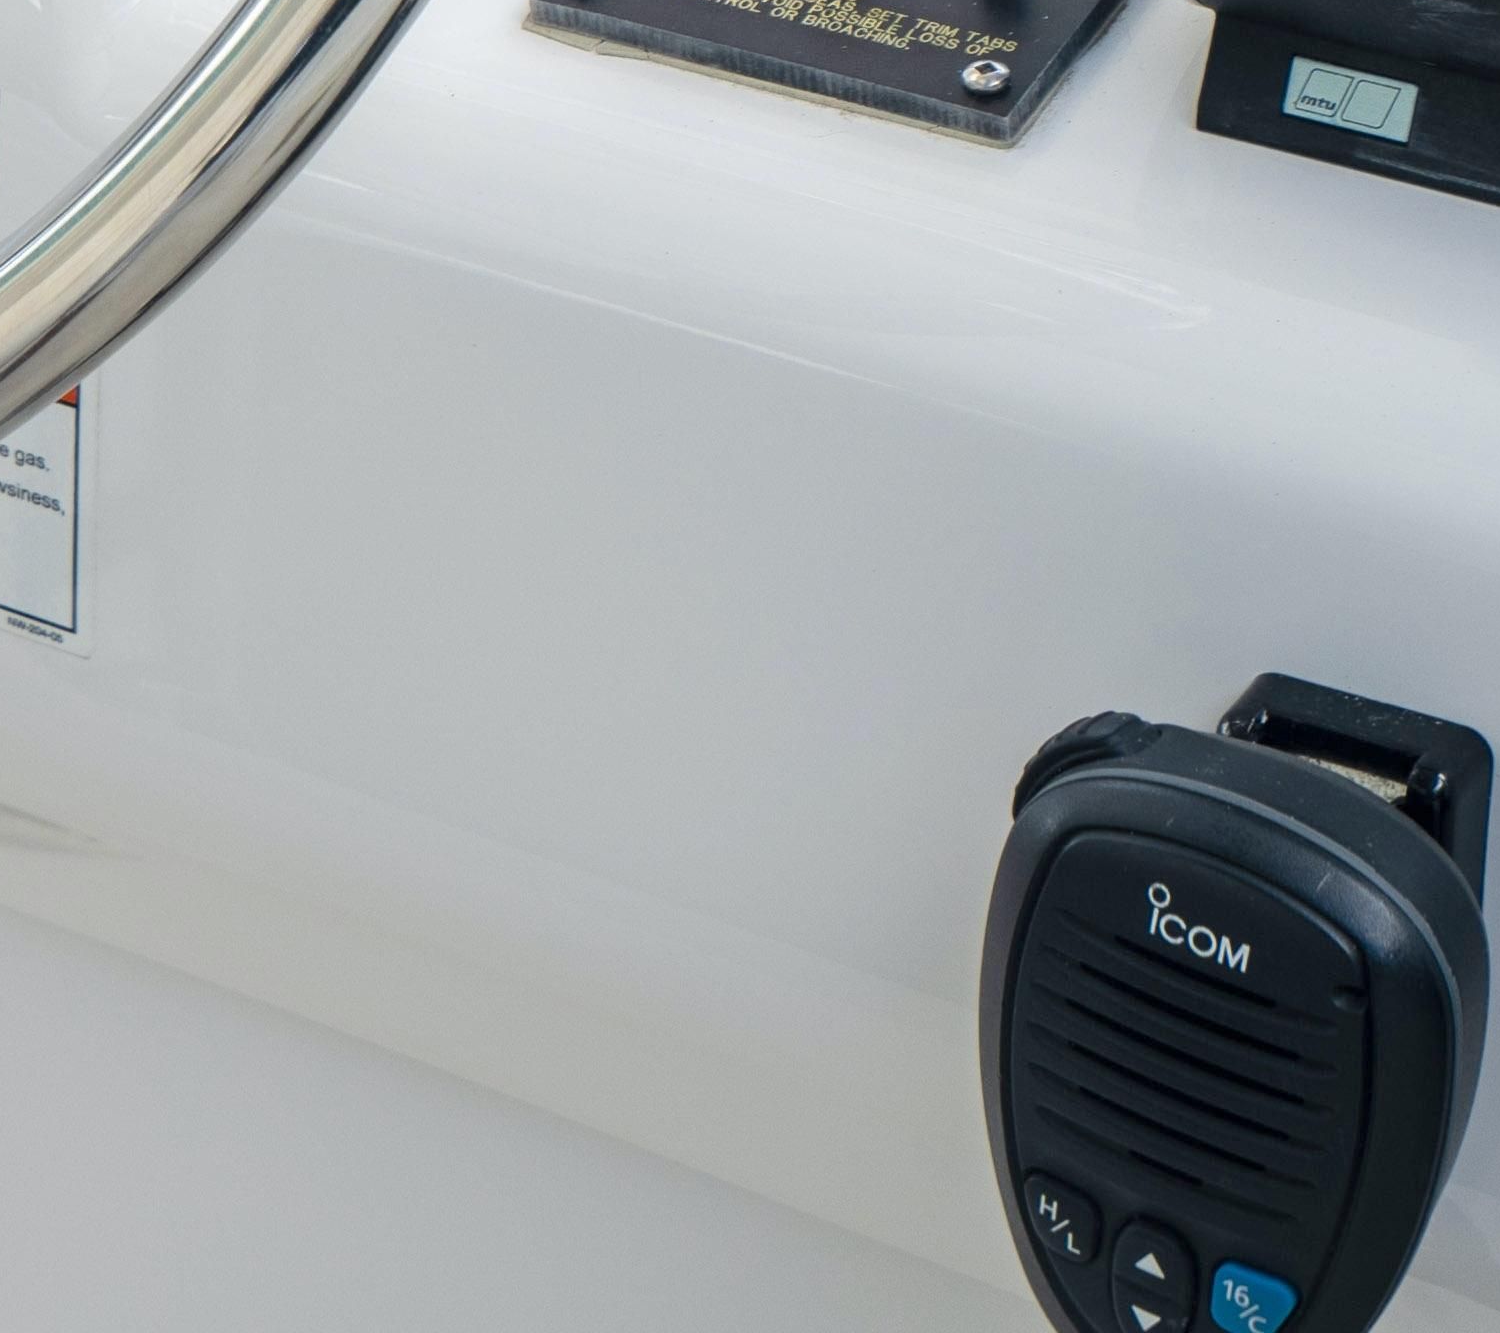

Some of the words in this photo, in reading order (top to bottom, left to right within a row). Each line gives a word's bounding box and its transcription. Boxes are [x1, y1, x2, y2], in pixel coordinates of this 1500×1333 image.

[769, 6, 800, 22] OR
[801, 13, 911, 51] BROACHING.
[808, 4, 904, 37] POSSIBLE
[905, 27, 961, 51] LOSS
[965, 42, 994, 57] OF
[866, 6, 909, 24] SET
[914, 17, 960, 39] TRIM
[967, 30, 1018, 54] TABS
[1300, 94, 1337, 111] mtu
[1037, 1192, 1082, 1257] H/L
